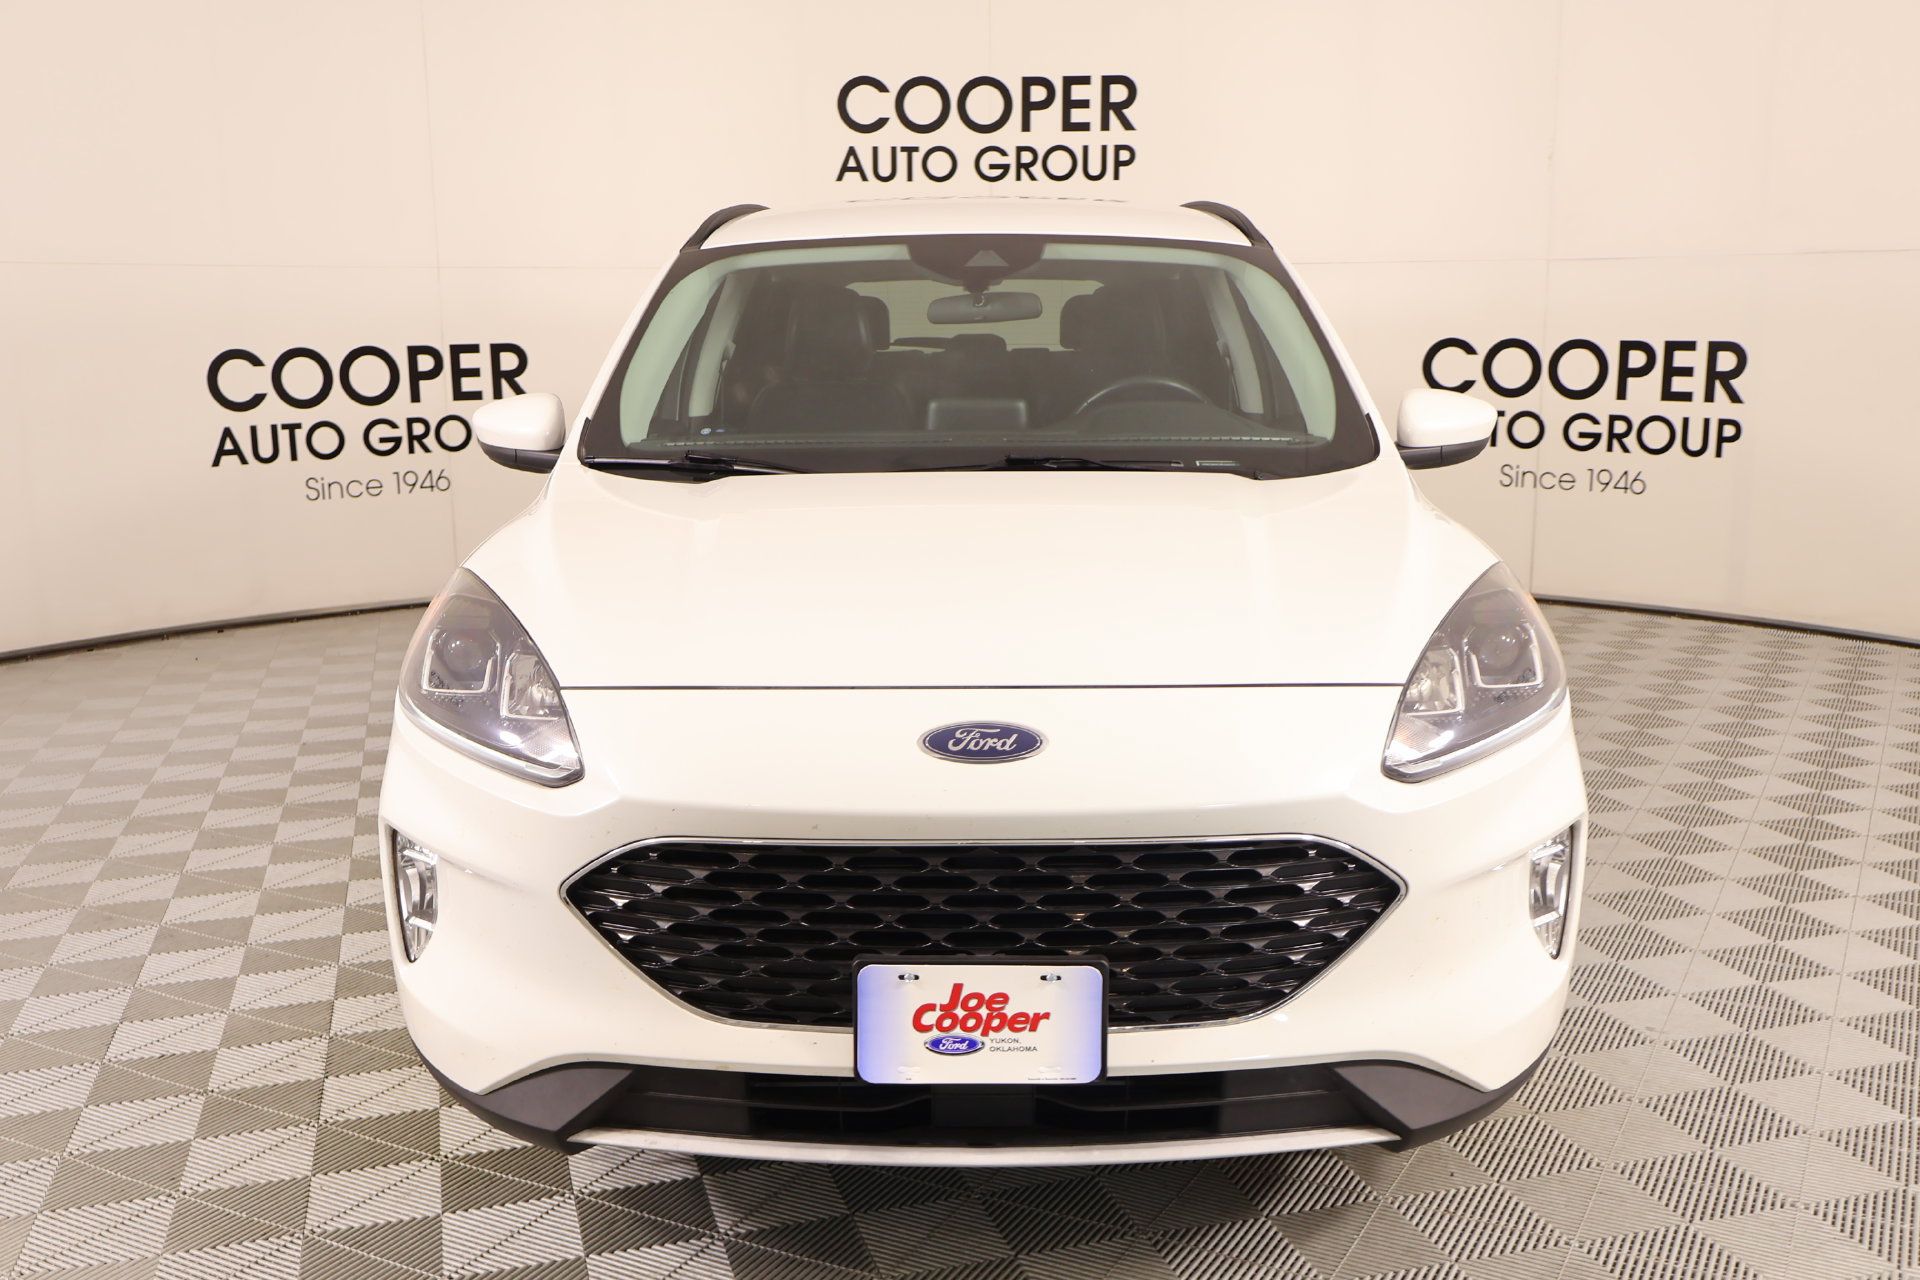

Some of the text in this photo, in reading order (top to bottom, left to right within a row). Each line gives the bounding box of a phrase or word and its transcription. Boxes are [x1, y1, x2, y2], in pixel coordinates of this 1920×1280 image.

[837, 75, 1138, 134] COOPER
[835, 144, 1136, 183] AUTO GROUP
[206, 342, 529, 412] COOPER
[1422, 337, 1748, 405] COOPER
[211, 414, 473, 468] AUTO GRO
[1489, 410, 1742, 458] TO GROUP
[305, 468, 453, 502] Since 1946
[1498, 463, 1648, 496] Since 1946
[947, 727, 1019, 752] Ford
[939, 982, 1010, 1012] Joe
[912, 1003, 1051, 1037] Cooper
